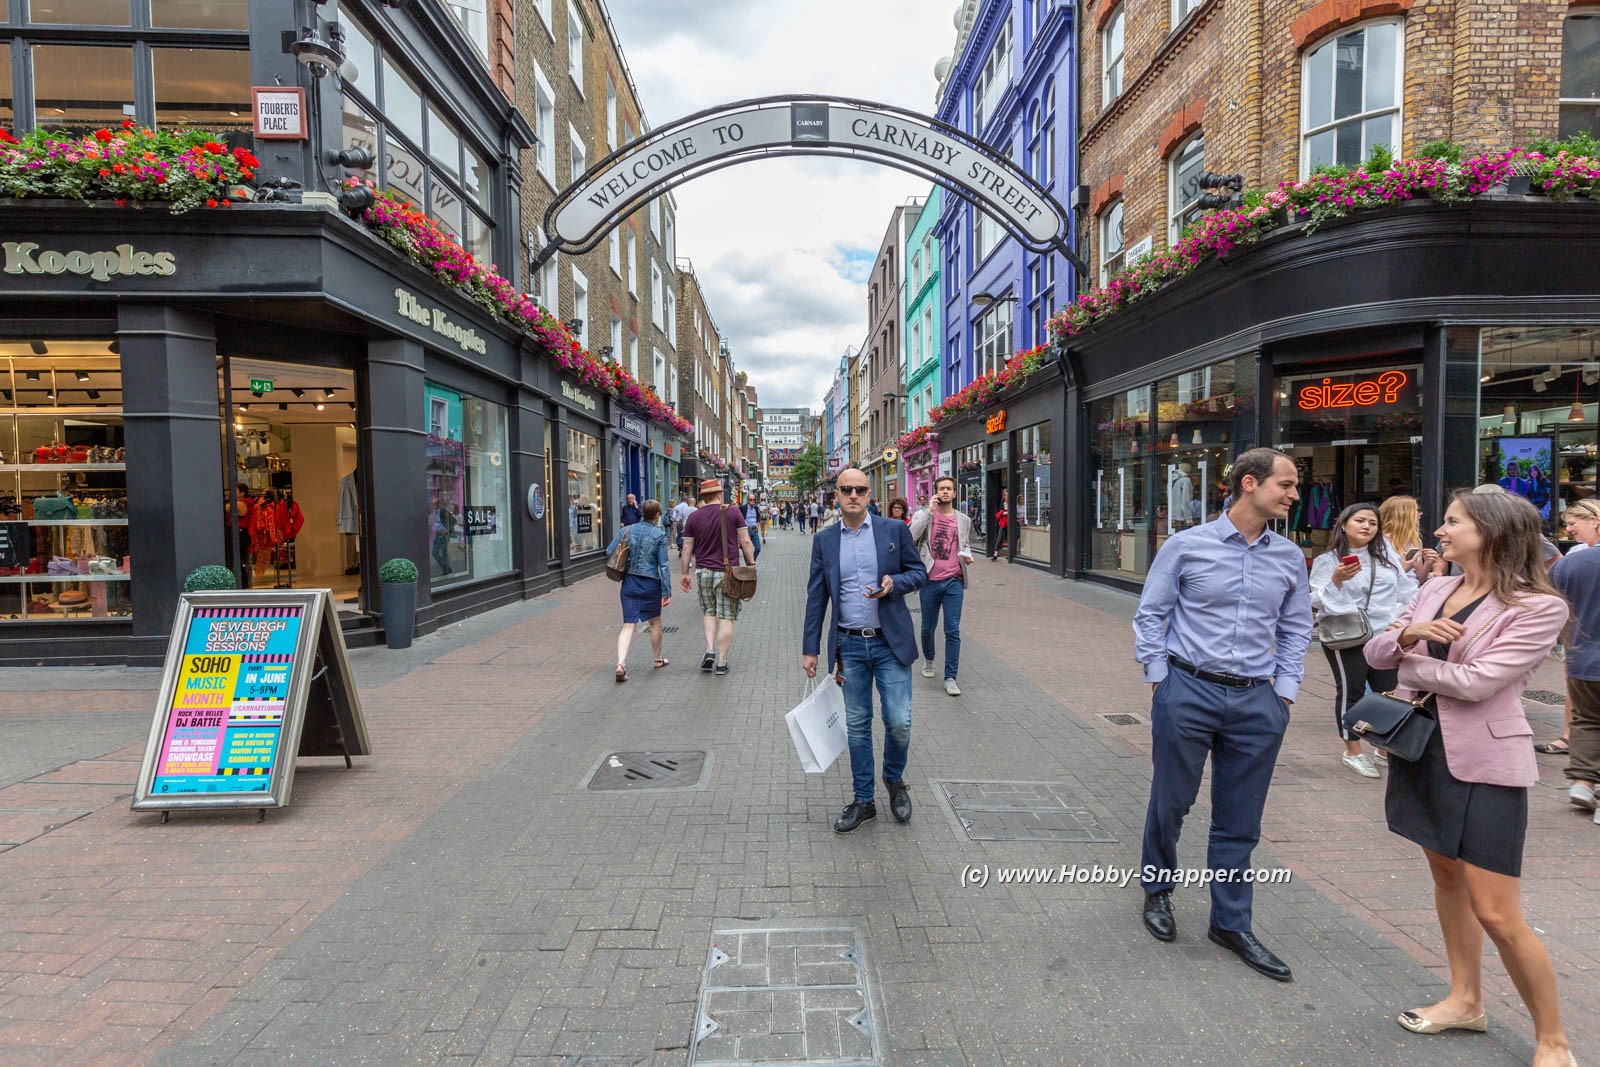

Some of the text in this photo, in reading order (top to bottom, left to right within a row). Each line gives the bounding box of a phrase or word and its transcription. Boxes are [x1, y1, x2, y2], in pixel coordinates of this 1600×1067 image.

[264, 118, 288, 130] PLACE
[587, 123, 744, 209] WELCOME TO
[852, 118, 1042, 223] CARNABY STREET
[1, 242, 176, 282] Kooples
[395, 288, 486, 355] The Kooples
[1299, 370, 1407, 410] size?
[986, 409, 1007, 434] size?
[467, 510, 492, 524] SALE
[579, 516, 591, 526] SALE
[209, 621, 287, 632] NEWBURGH
[207, 631, 271, 642] QUARTER
[205, 641, 267, 652] SESSIONS
[190, 657, 231, 673] SOHO
[186, 676, 228, 690] MUSIC
[245, 673, 287, 684] IN JUNE
[182, 693, 224, 705] MONTH
[176, 717, 222, 728] DJ BATTLE
[167, 752, 214, 762] SHOWCASE
